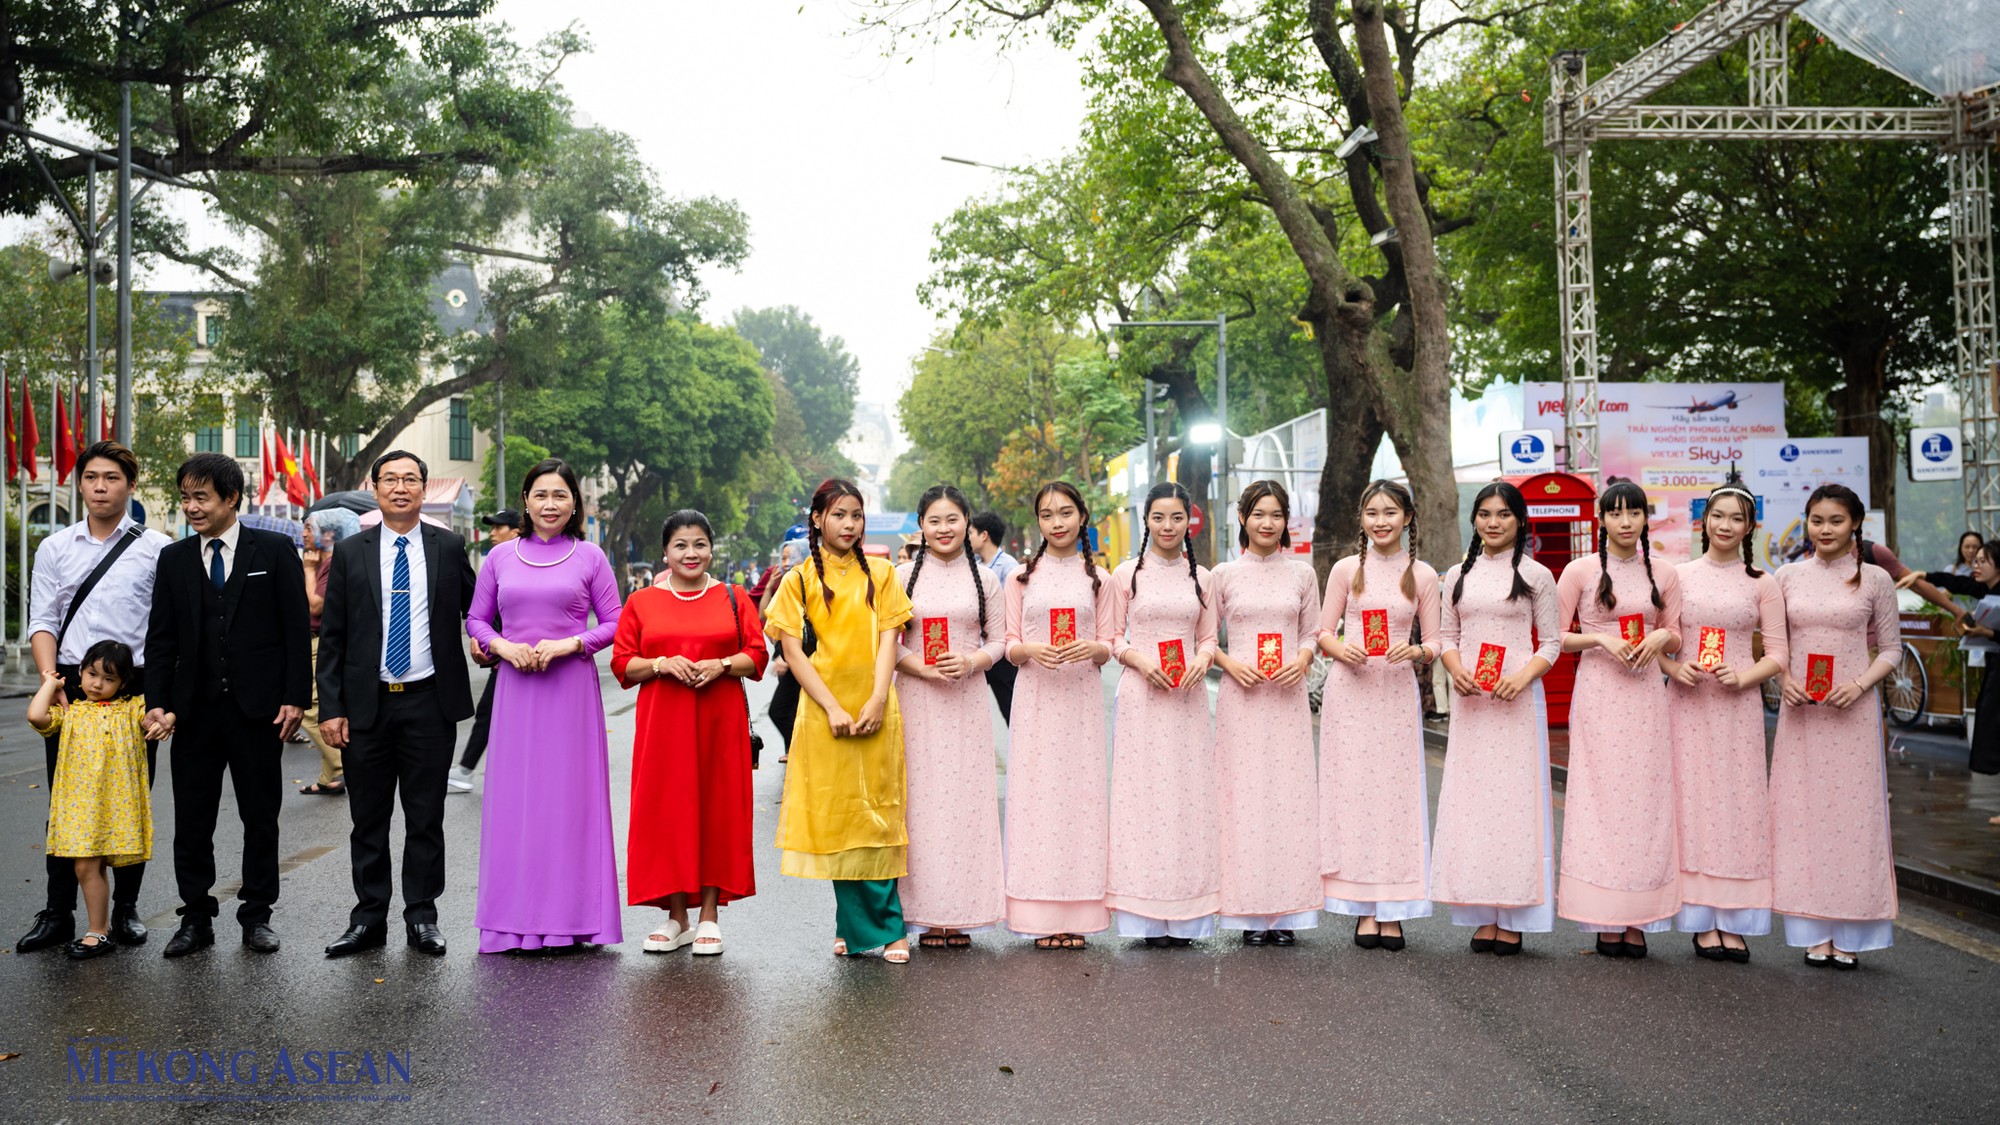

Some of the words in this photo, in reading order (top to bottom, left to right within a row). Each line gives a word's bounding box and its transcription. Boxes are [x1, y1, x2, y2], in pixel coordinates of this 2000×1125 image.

[1689, 425, 1720, 433] PHONG
[1650, 450, 1685, 458] VIETJET
[1661, 475, 1698, 487] 3.000
[1531, 507, 1575, 515] TELEPHONE
